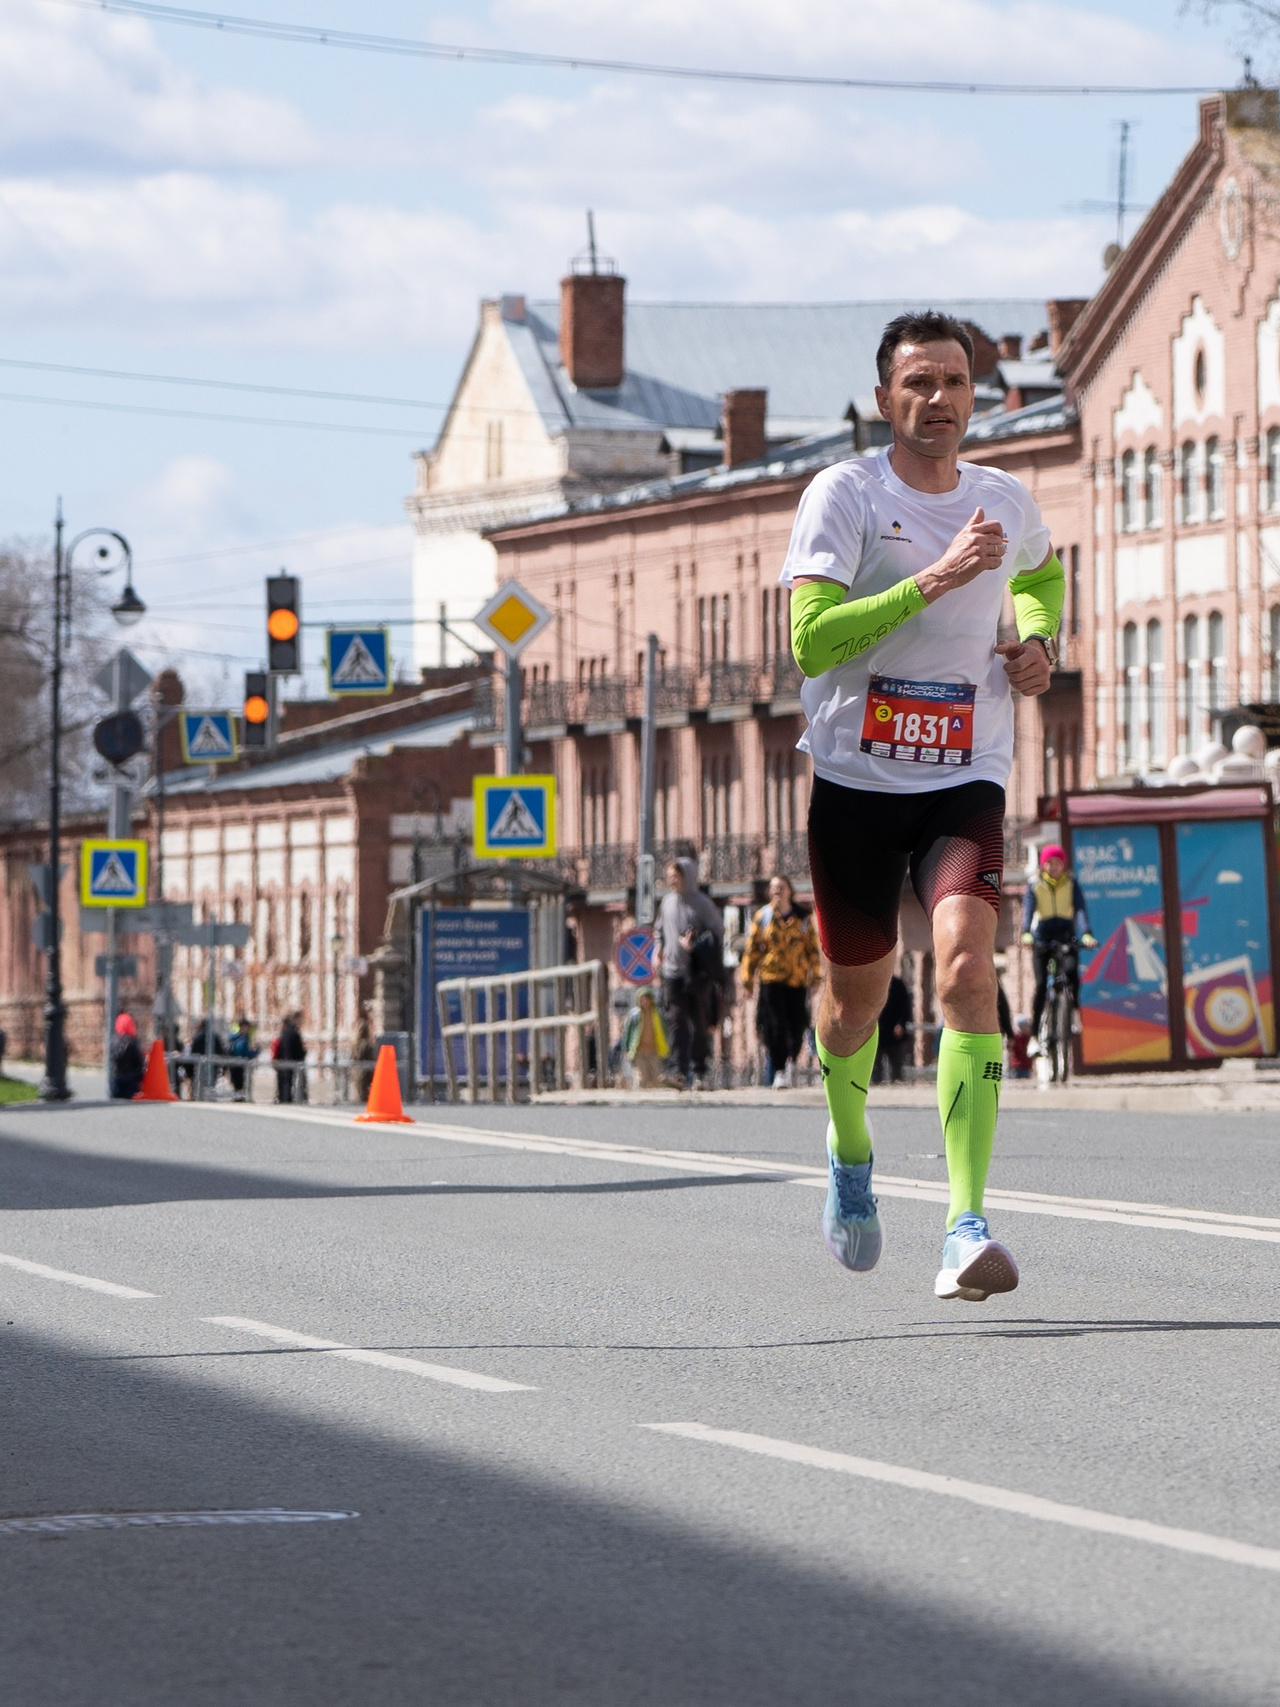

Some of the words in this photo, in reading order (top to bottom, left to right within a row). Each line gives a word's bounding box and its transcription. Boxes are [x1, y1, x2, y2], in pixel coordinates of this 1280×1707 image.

[902, 689, 946, 698] КОСМОС
[892, 712, 949, 745] 1831
[1075, 845, 1118, 863] КВАС
[1078, 865, 1159, 884] ЛИМОНАД
